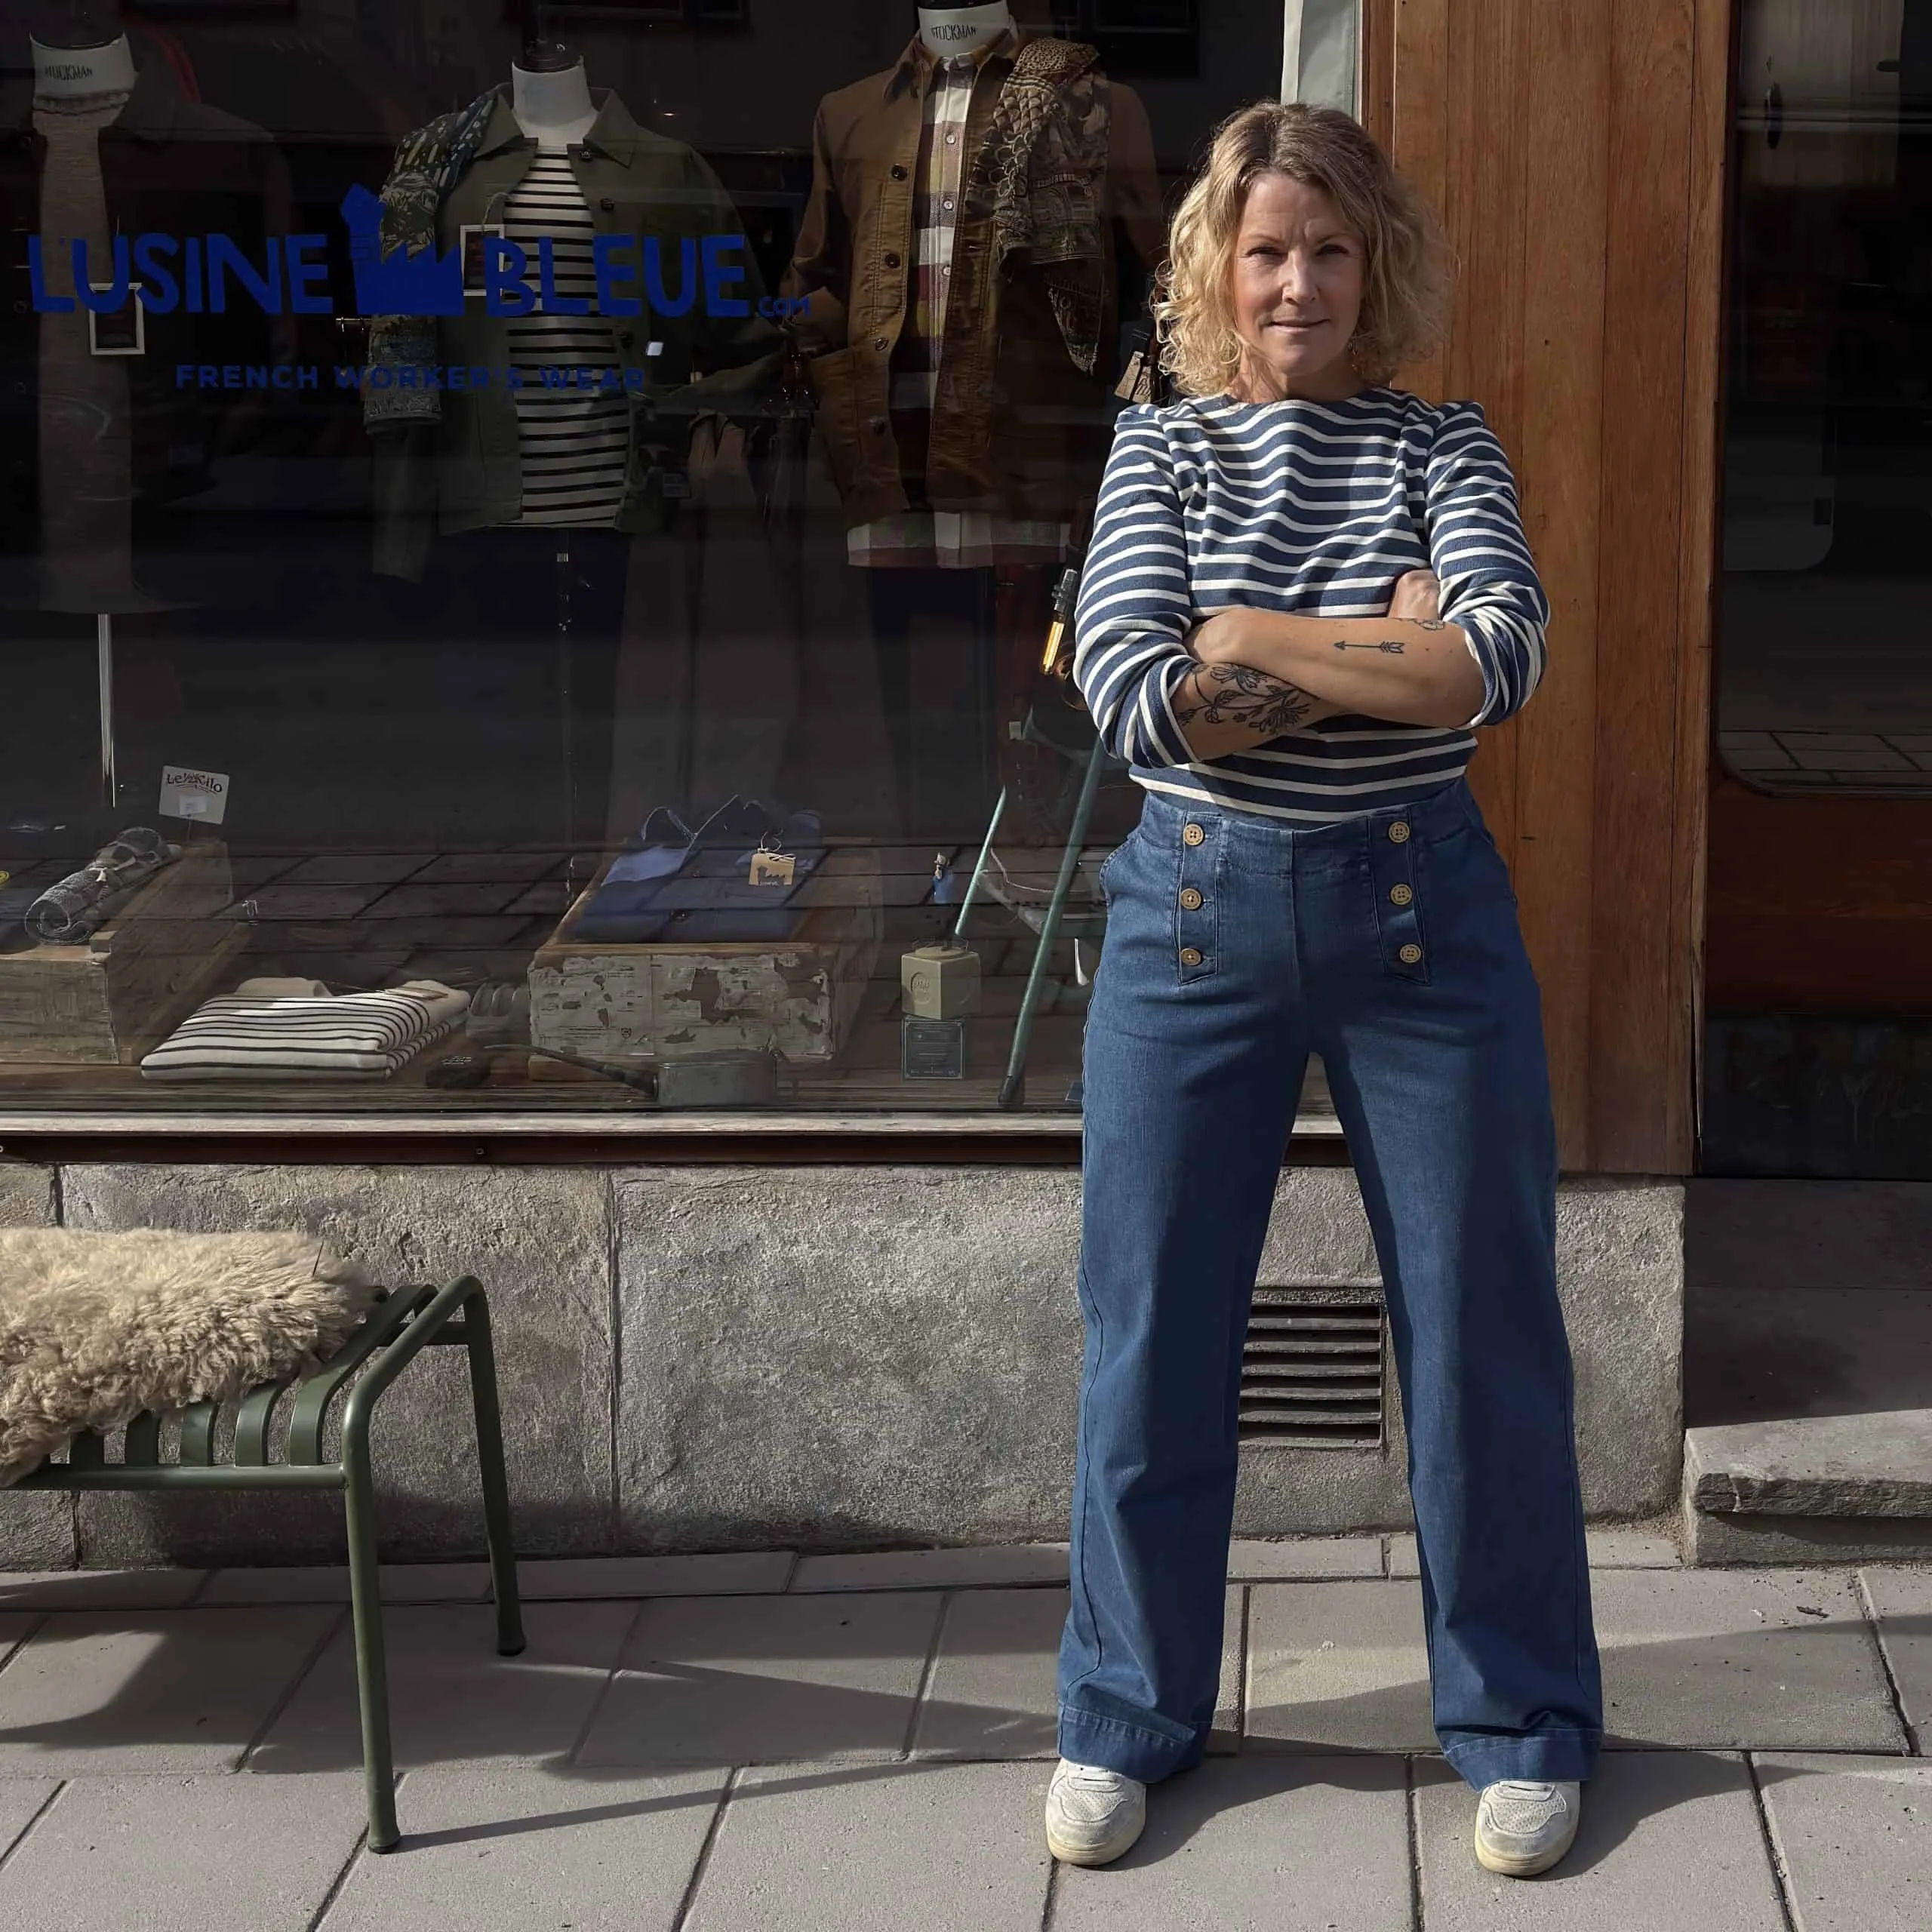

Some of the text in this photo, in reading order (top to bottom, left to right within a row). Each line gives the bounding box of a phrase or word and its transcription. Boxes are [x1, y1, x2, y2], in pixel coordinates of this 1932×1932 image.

[175, 365, 645, 392] FRENCH WORKER'S WEAR
